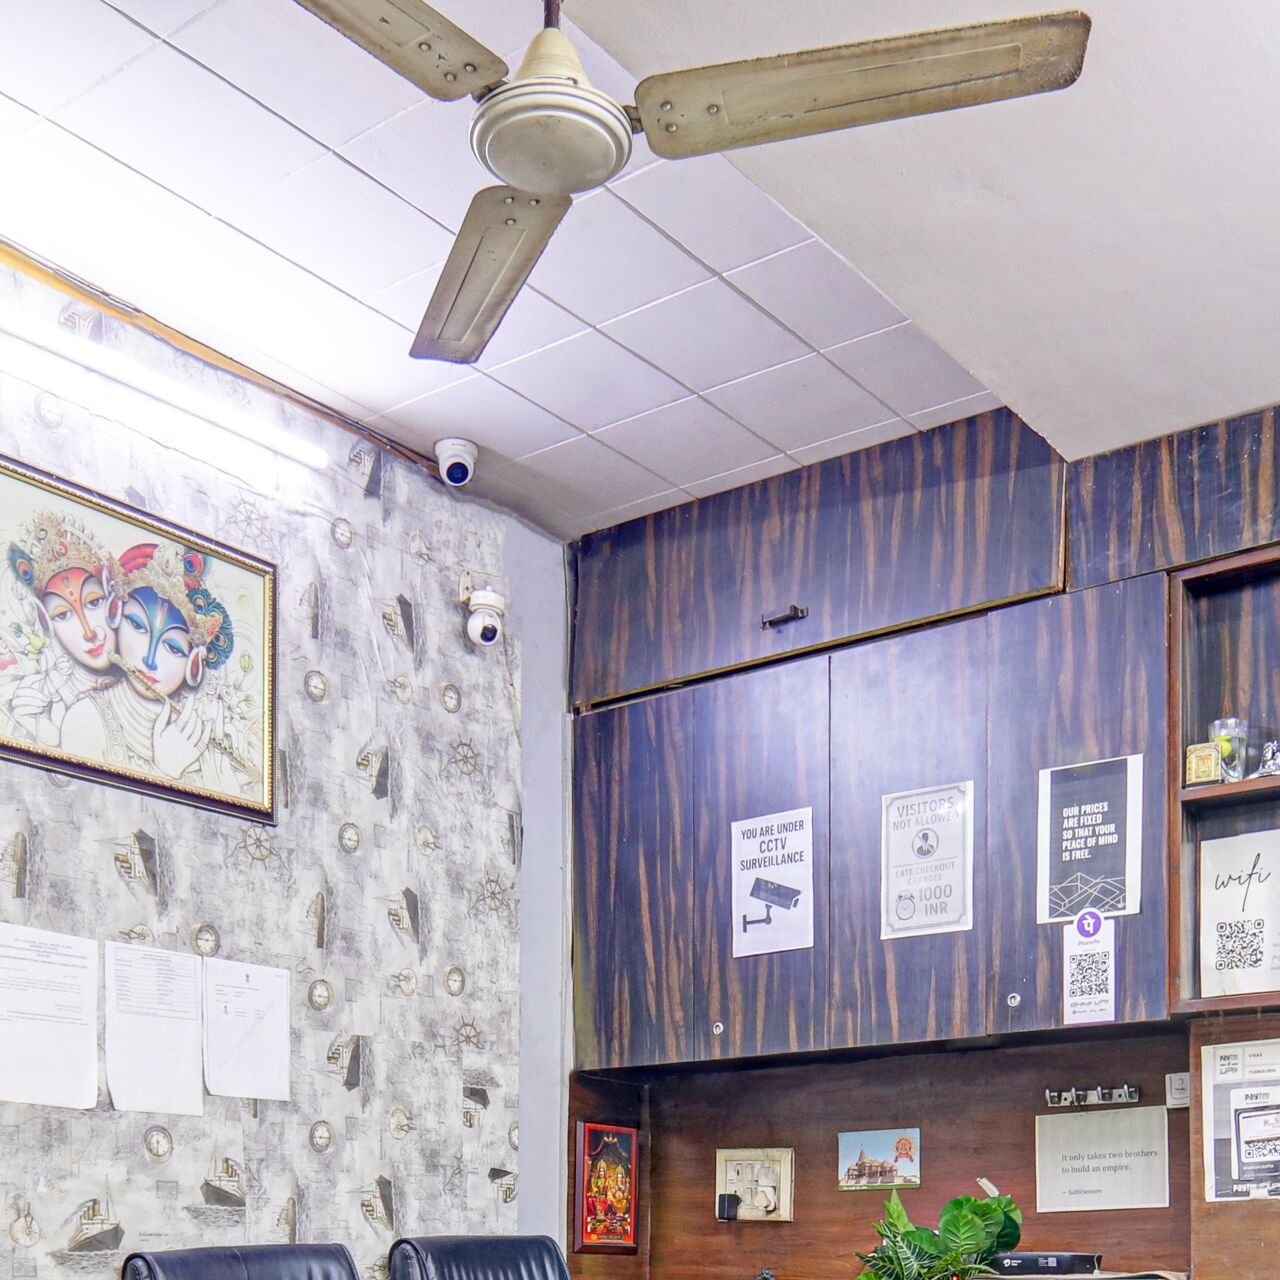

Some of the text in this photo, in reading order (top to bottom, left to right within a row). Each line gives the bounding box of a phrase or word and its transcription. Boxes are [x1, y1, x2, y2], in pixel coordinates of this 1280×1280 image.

[897, 797, 954, 817] VISITORS
[1063, 802, 1108, 817] OUR PRICES
[893, 810, 959, 831] NOT ALLOWED
[1063, 814, 1102, 828] ARE FIXED
[741, 820, 804, 840] YOU ARE UNDER
[1063, 824, 1116, 839] SO THAT YOUR
[759, 836, 787, 853] CCTV
[1063, 834, 1118, 850] PEACE OF MIND
[740, 851, 804, 871] SURVEILLANCE
[1063, 849, 1091, 861] IS FREE.
[915, 862, 954, 875] CHECKOUT
[1215, 853, 1271, 912] wifi
[919, 884, 952, 902] 1000
[925, 902, 948, 916] INR
[1069, 1154, 1085, 1163] only
[1087, 1152, 1106, 1160] takes
[1125, 1149, 1157, 1157] brothers
[1062, 1166, 1069, 1174] to
[1071, 1165, 1090, 1173] build
